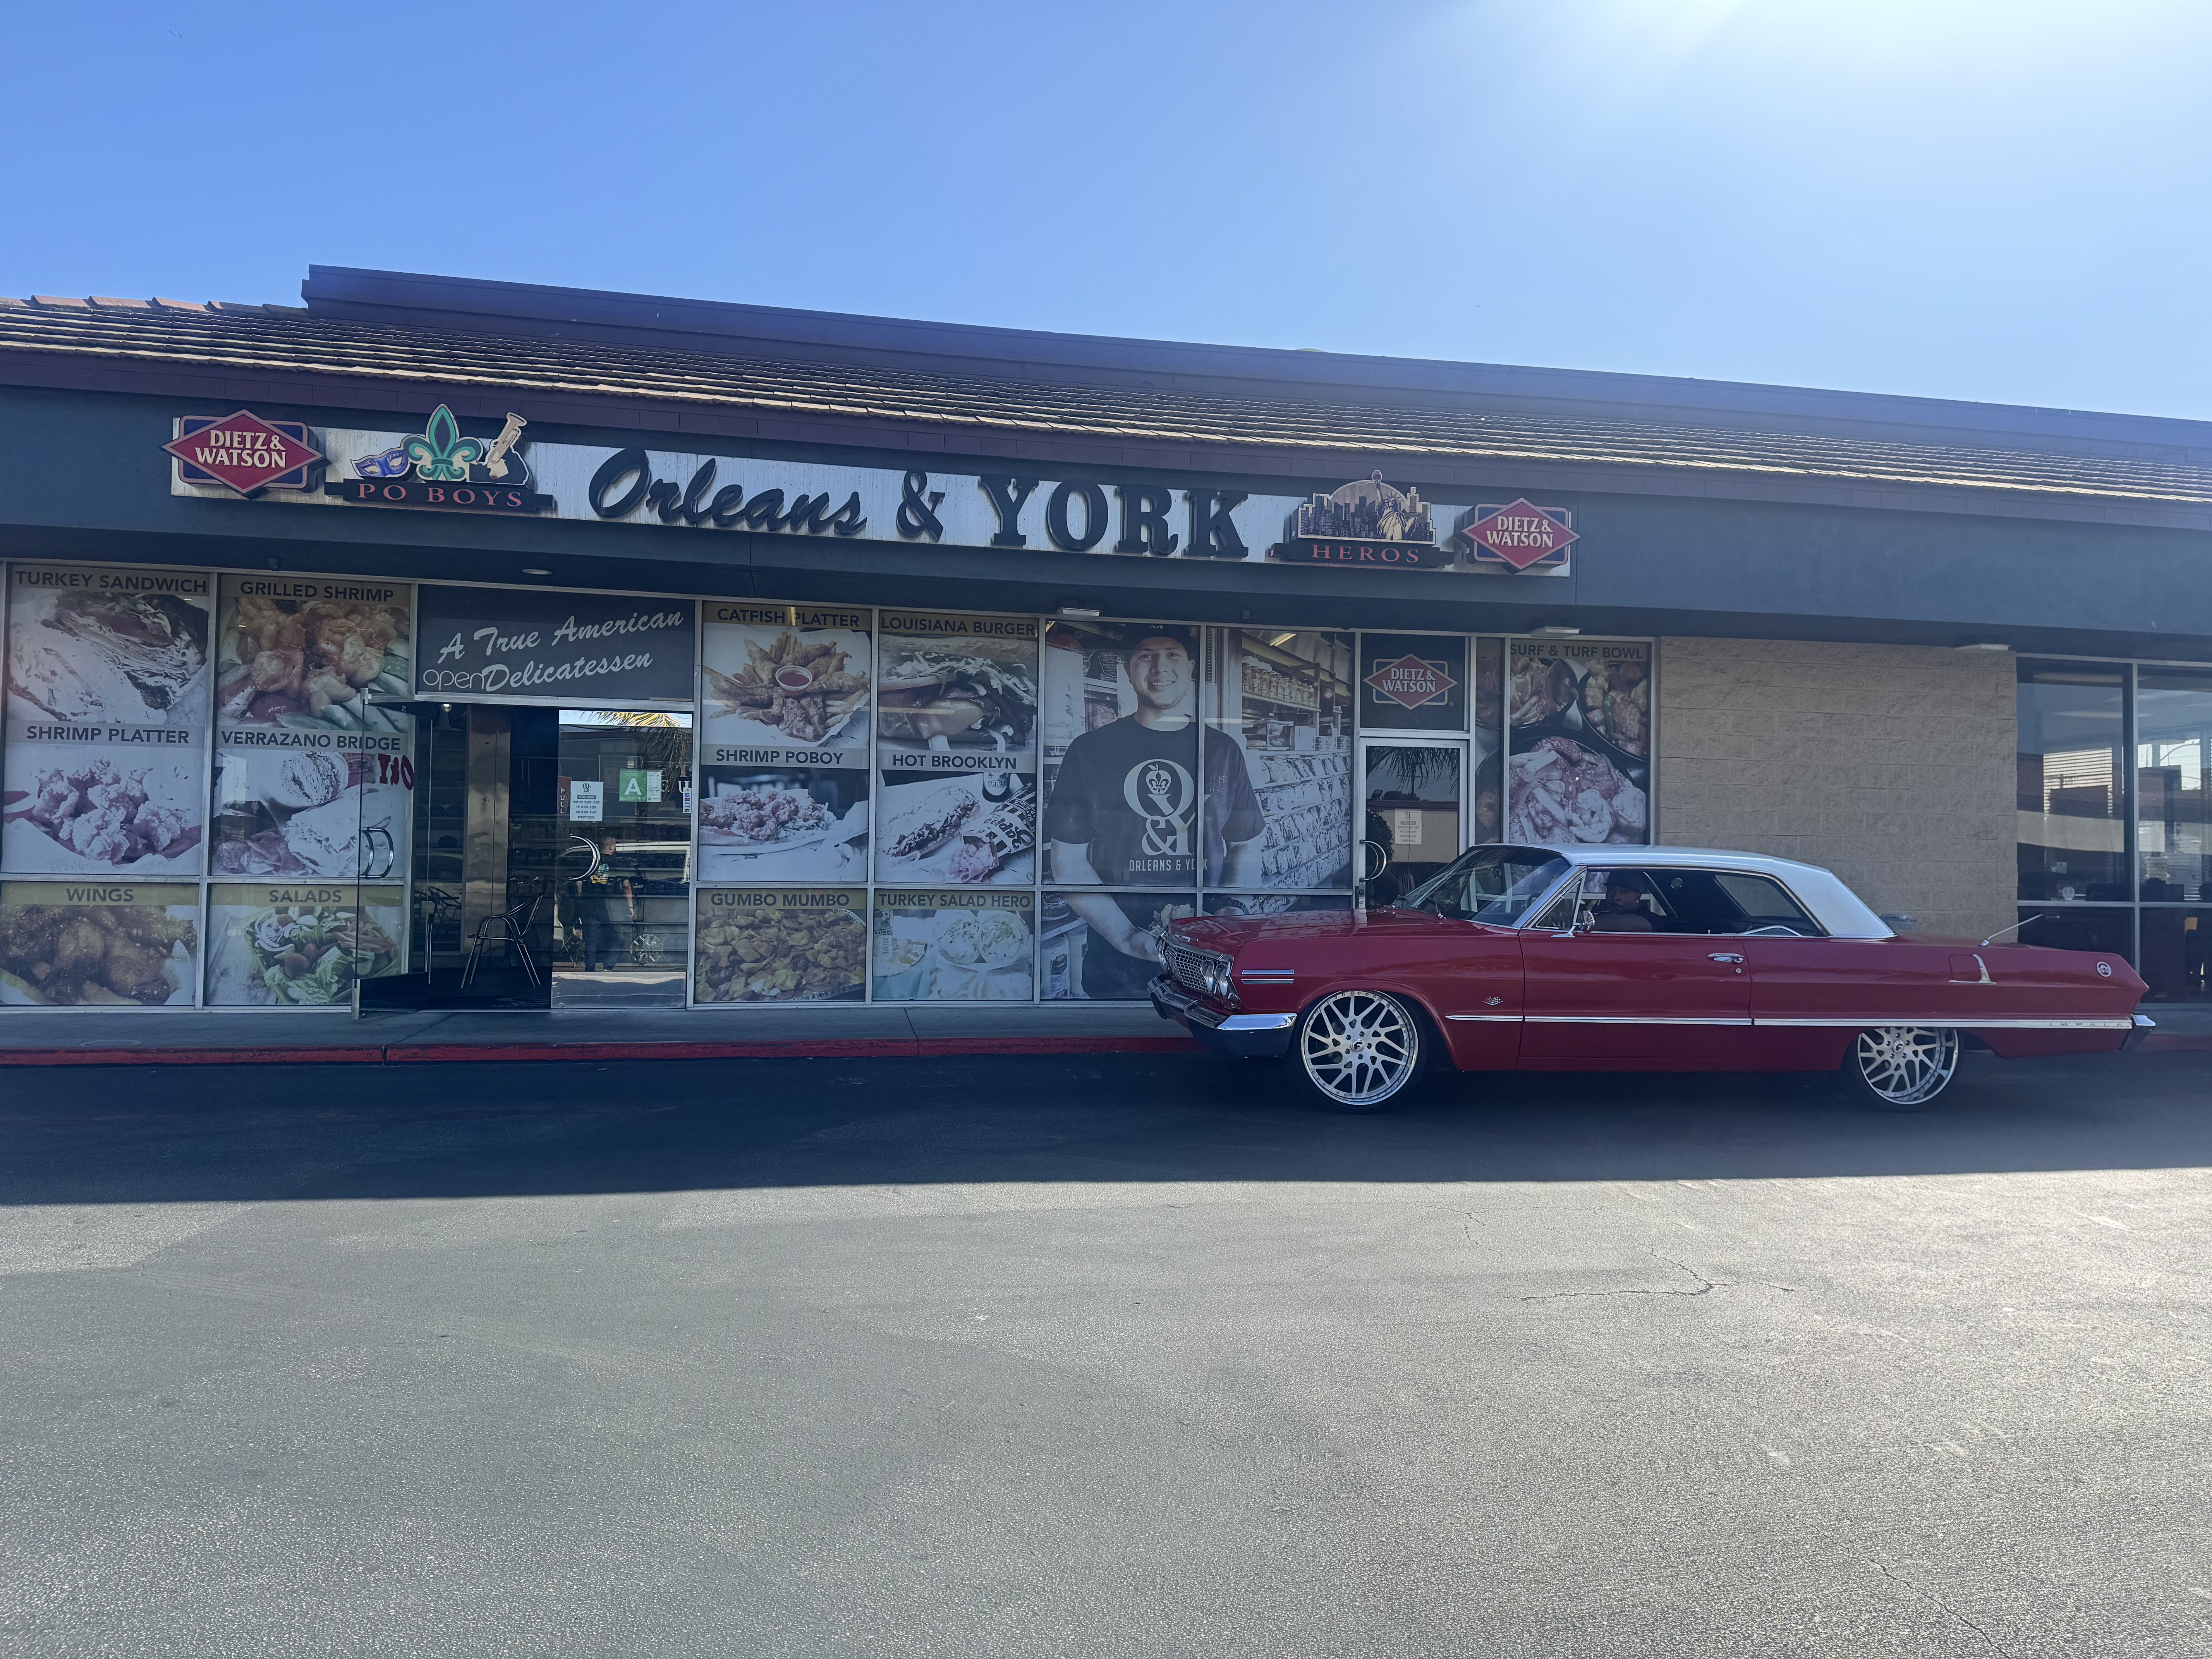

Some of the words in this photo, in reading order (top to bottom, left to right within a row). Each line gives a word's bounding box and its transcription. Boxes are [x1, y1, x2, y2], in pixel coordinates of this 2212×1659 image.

[210, 430, 267, 450] DIETZ
[270, 434, 285, 450] &
[194, 447, 287, 468] WATSON
[357, 483, 406, 501] PO
[427, 487, 522, 507] BOYS
[588, 447, 867, 535] Orleans
[895, 468, 946, 542] &
[977, 474, 1249, 558] YORK
[1497, 516, 1540, 532] DIETZ
[1541, 520, 1554, 532] &
[1486, 531, 1554, 549] WATSON
[1311, 544, 1419, 563] HEROS
[15, 570, 94, 588] TURKEY
[99, 575, 207, 593] SANDWICH
[240, 581, 317, 598] GRILLED
[323, 586, 394, 602] SHRIMP
[717, 608, 785, 623] CATFISH
[793, 612, 860, 627] PLATTER
[881, 617, 968, 632] LOUISIANA
[973, 621, 1037, 636] BURGER
[438, 632, 465, 664] A
[473, 626, 541, 656] True
[551, 611, 684, 646] American
[1510, 644, 1544, 656] SURF
[1549, 646, 1559, 656] &
[1563, 646, 1598, 658] TURF
[1602, 647, 1643, 659] BOWL
[423, 669, 484, 691] open
[481, 652, 653, 692] Delicatessen
[1391, 668, 1425, 681] DIETZ
[1426, 670, 1435, 681] &
[1382, 680, 1436, 693] WATSON
[26, 725, 102, 741] SHRIMP
[108, 728, 189, 744] PLATTER
[221, 730, 331, 748] VERRAZANO
[337, 735, 400, 751] BRIDGE
[716, 749, 780, 763] SHRIMP
[785, 750, 844, 765] POBOY
[892, 754, 929, 767] HOT
[931, 755, 1017, 769] BROOKLYN
[624, 778, 642, 795] A
[1129, 859, 1171, 871] ORLEANS
[1176, 859, 1182, 871] &
[1185, 859, 1208, 870] YOK
[65, 887, 134, 902] WINGS
[268, 889, 342, 903] SALADS
[711, 893, 777, 907] GUMBO
[782, 893, 850, 907] MUMBO
[879, 893, 935, 907] TURKEY
[939, 894, 986, 907] SALAD
[991, 895, 1030, 908] HERO
